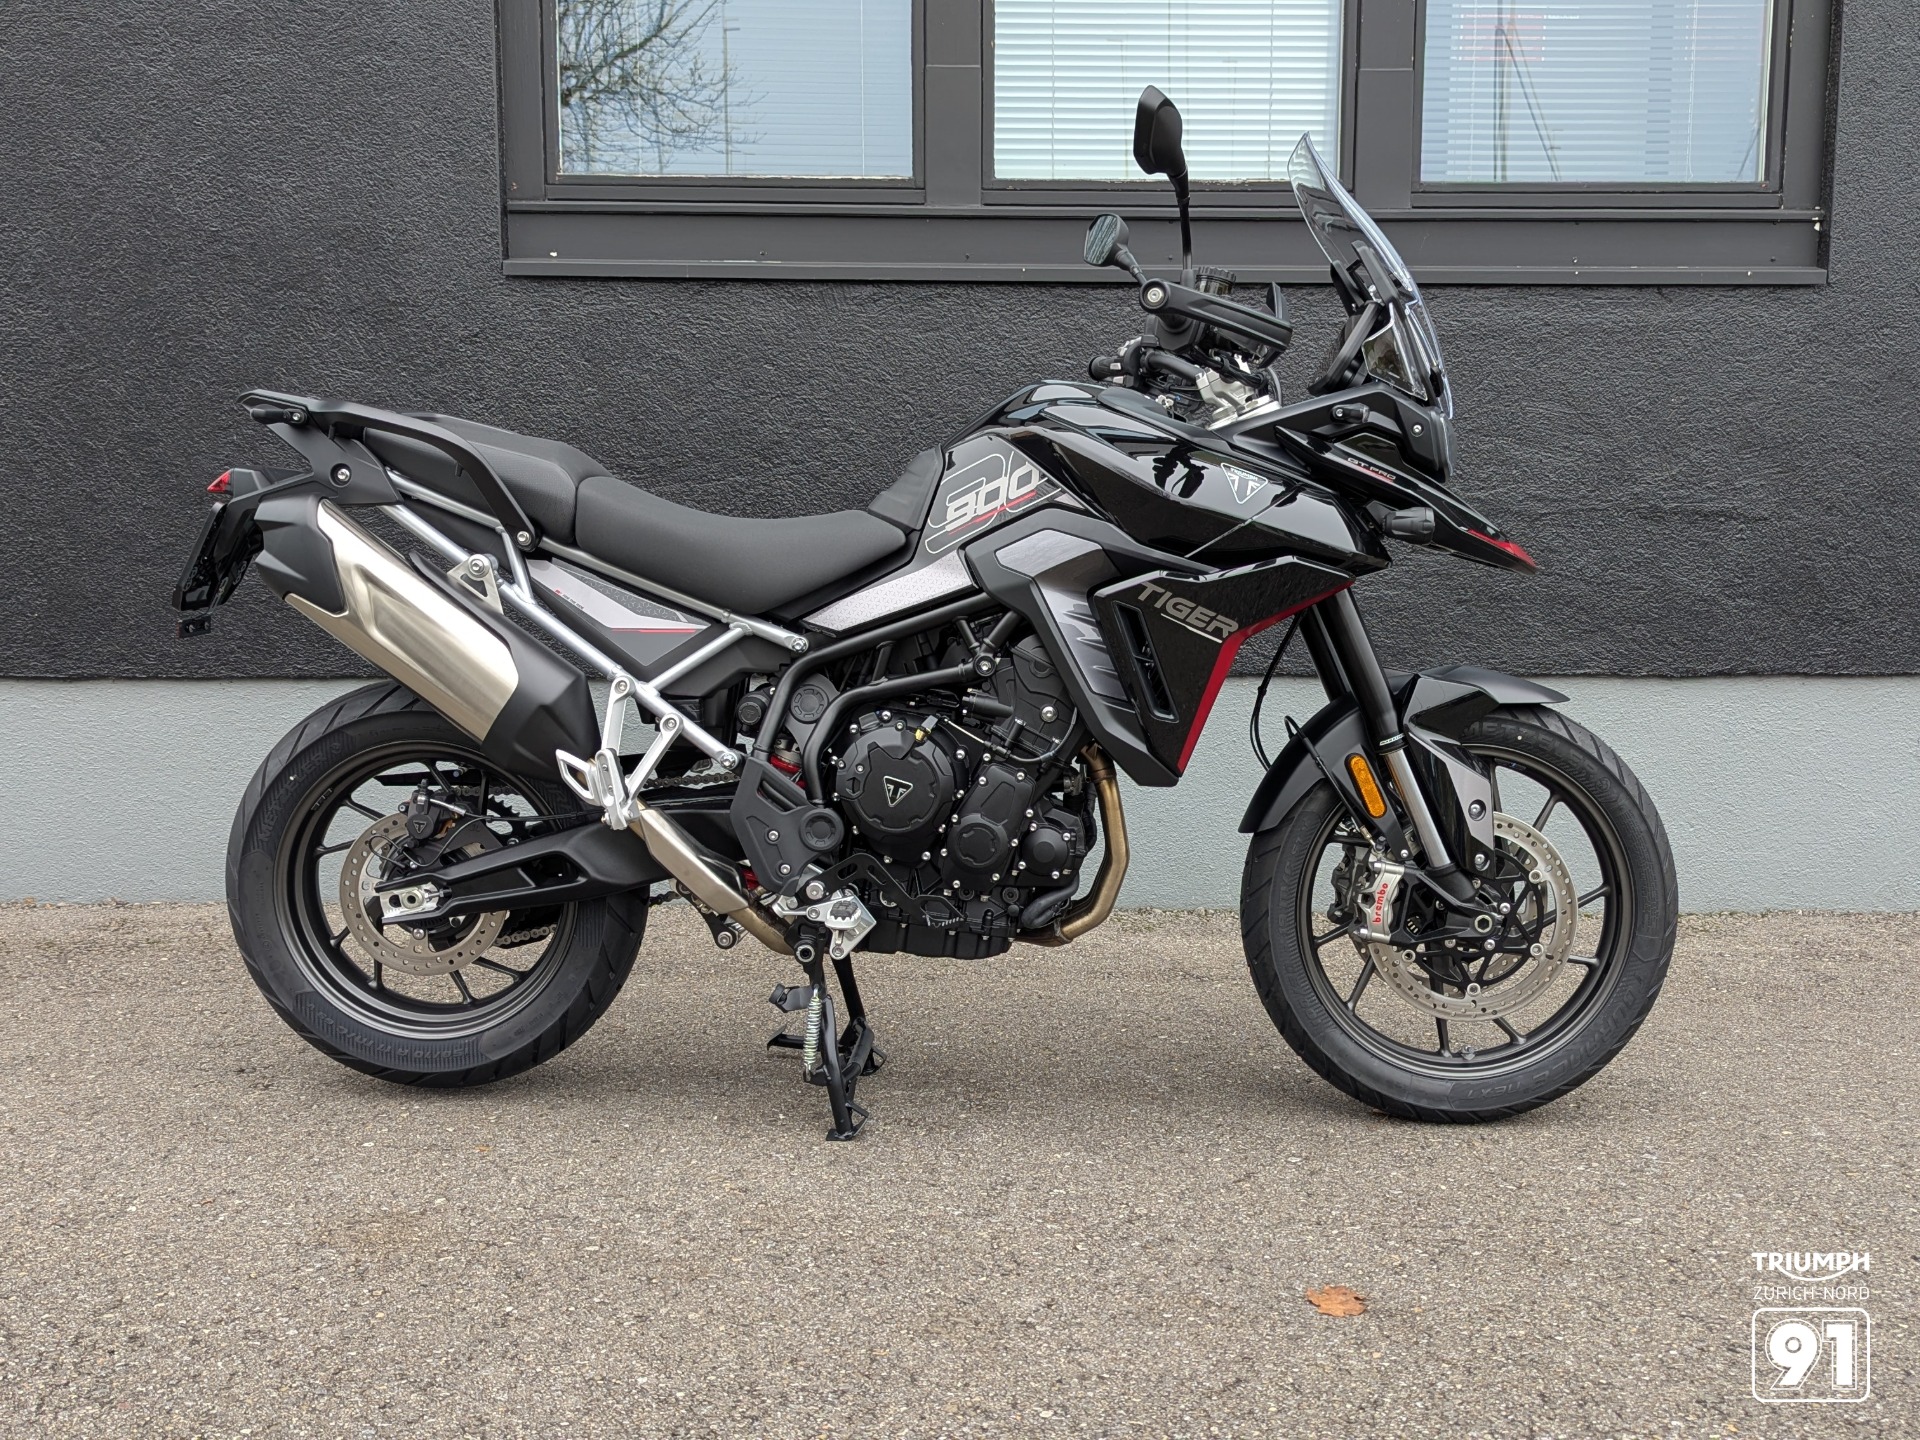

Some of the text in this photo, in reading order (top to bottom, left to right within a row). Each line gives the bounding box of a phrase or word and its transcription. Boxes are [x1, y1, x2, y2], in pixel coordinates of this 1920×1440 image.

[944, 461, 1040, 532] 800
[1370, 466, 1396, 480] PRO
[1137, 581, 1239, 639] TIGER
[259, 752, 328, 842] METZELER
[1372, 882, 1389, 923] brembo
